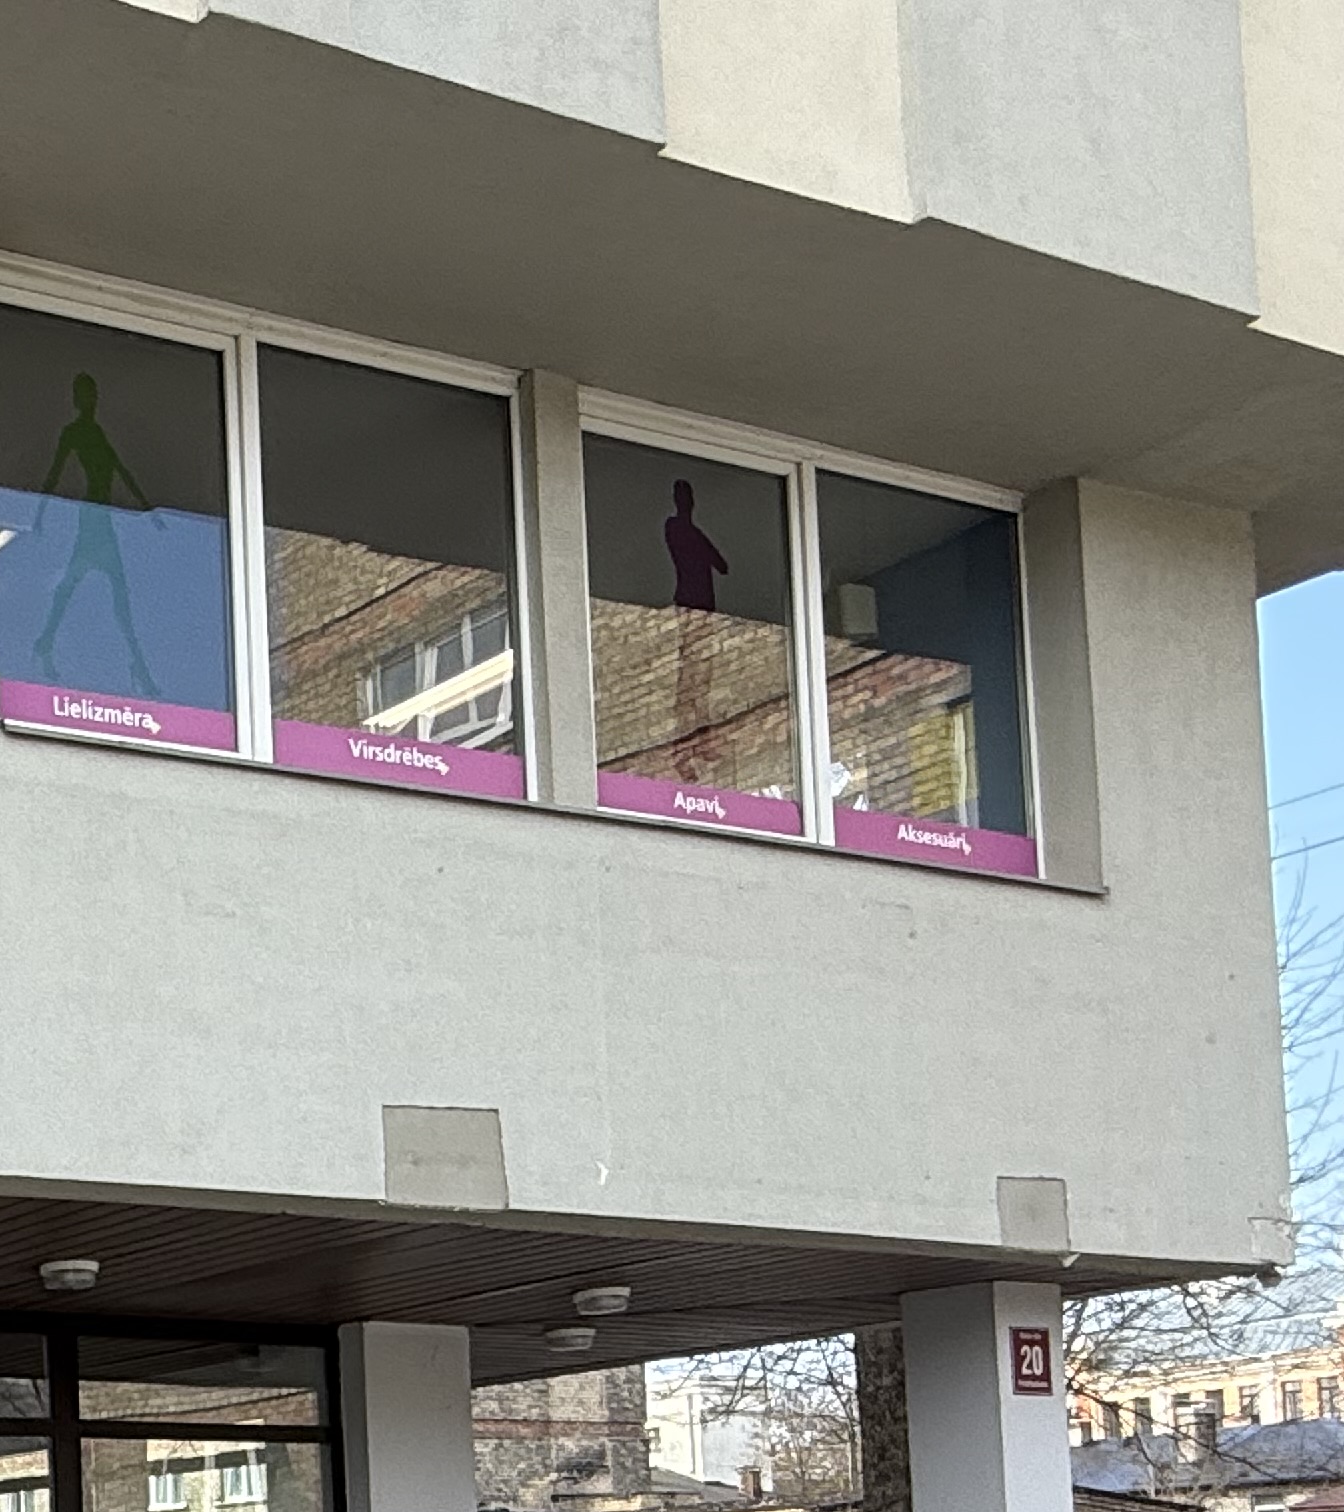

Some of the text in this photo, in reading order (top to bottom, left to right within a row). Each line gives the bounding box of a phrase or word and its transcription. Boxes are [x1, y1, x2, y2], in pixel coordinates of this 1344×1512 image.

[53, 695, 153, 729] Lielizmēra
[348, 738, 443, 770] Virsdrēbes
[673, 791, 719, 815] Apavi
[1020, 1344, 1044, 1376] 20
